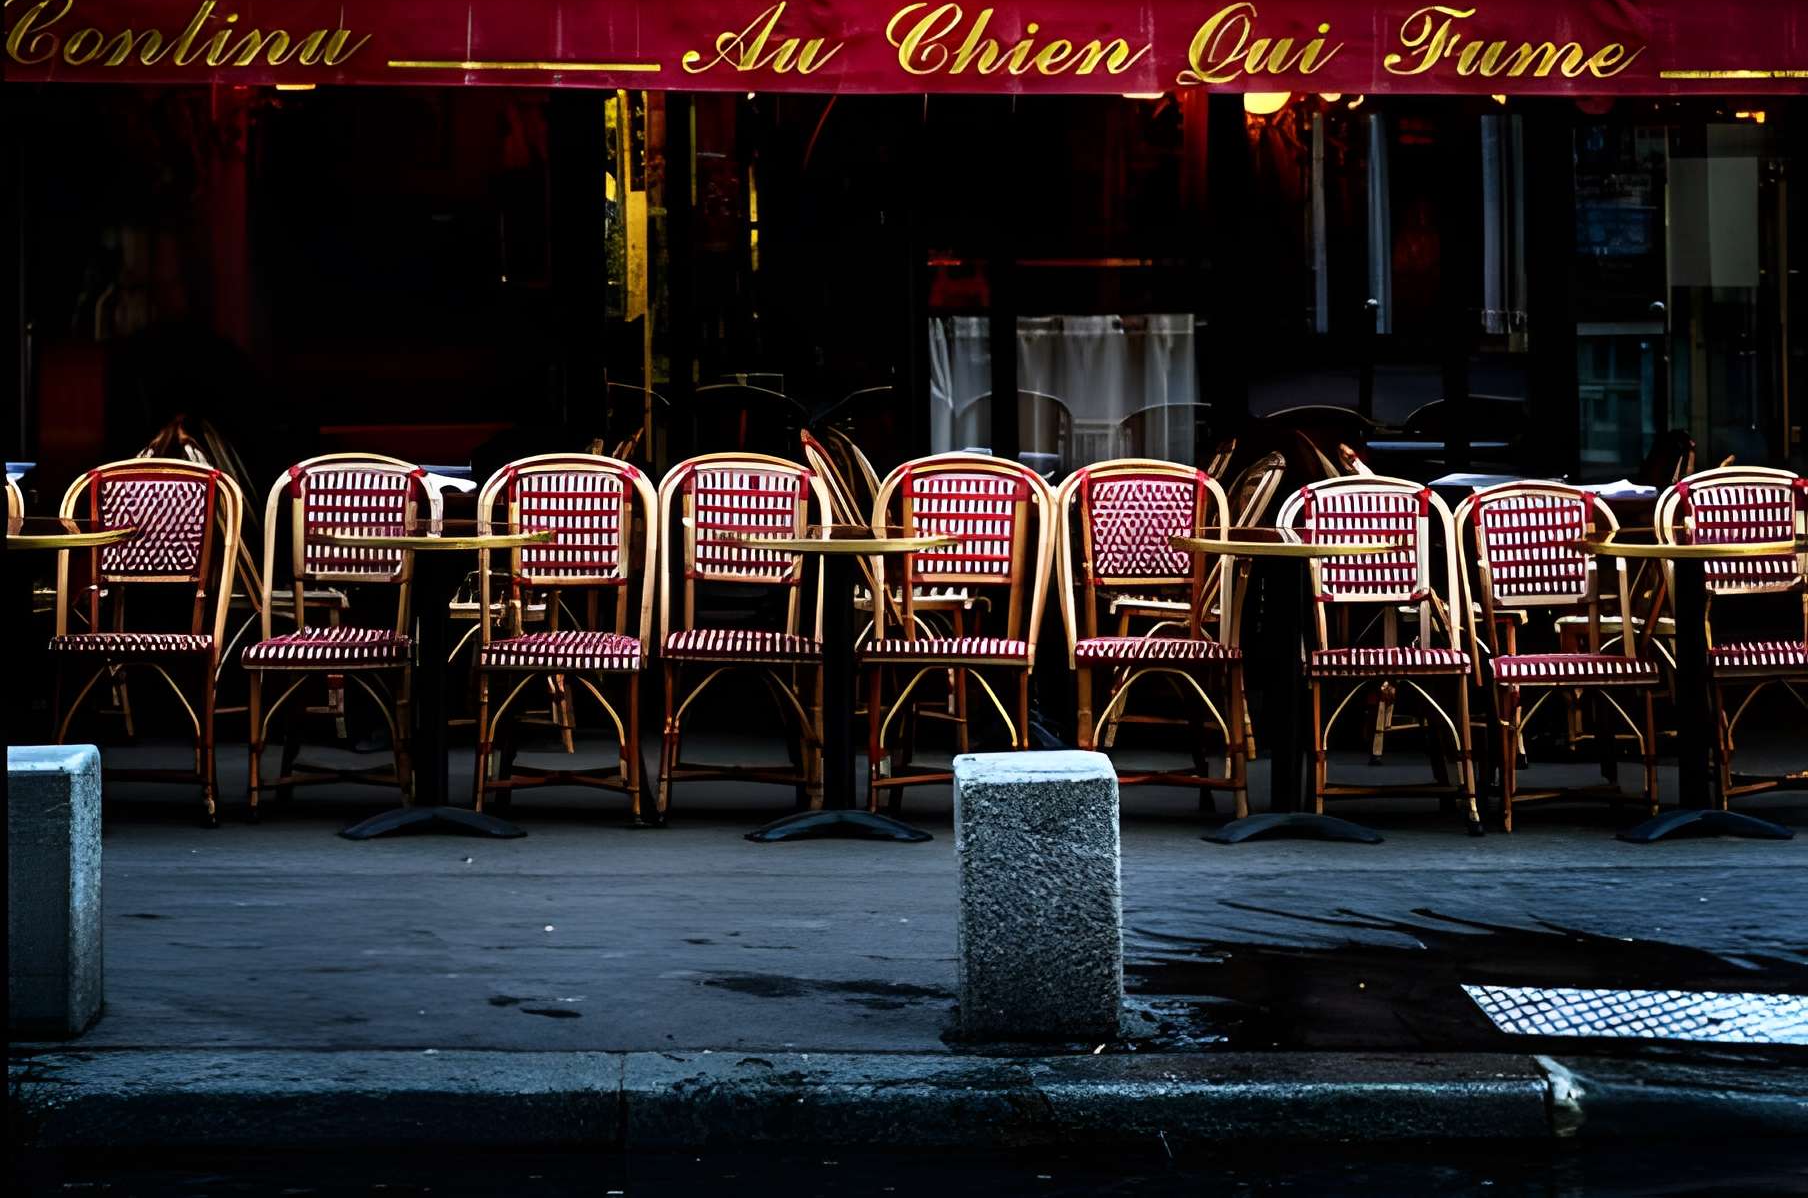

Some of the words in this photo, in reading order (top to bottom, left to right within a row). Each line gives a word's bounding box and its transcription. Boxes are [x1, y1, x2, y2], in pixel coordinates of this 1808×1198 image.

[681, 1, 844, 74] Au
[886, 2, 1152, 75] Chien
[1176, 2, 1344, 84] Qui
[1384, 5, 1646, 78] Fume
